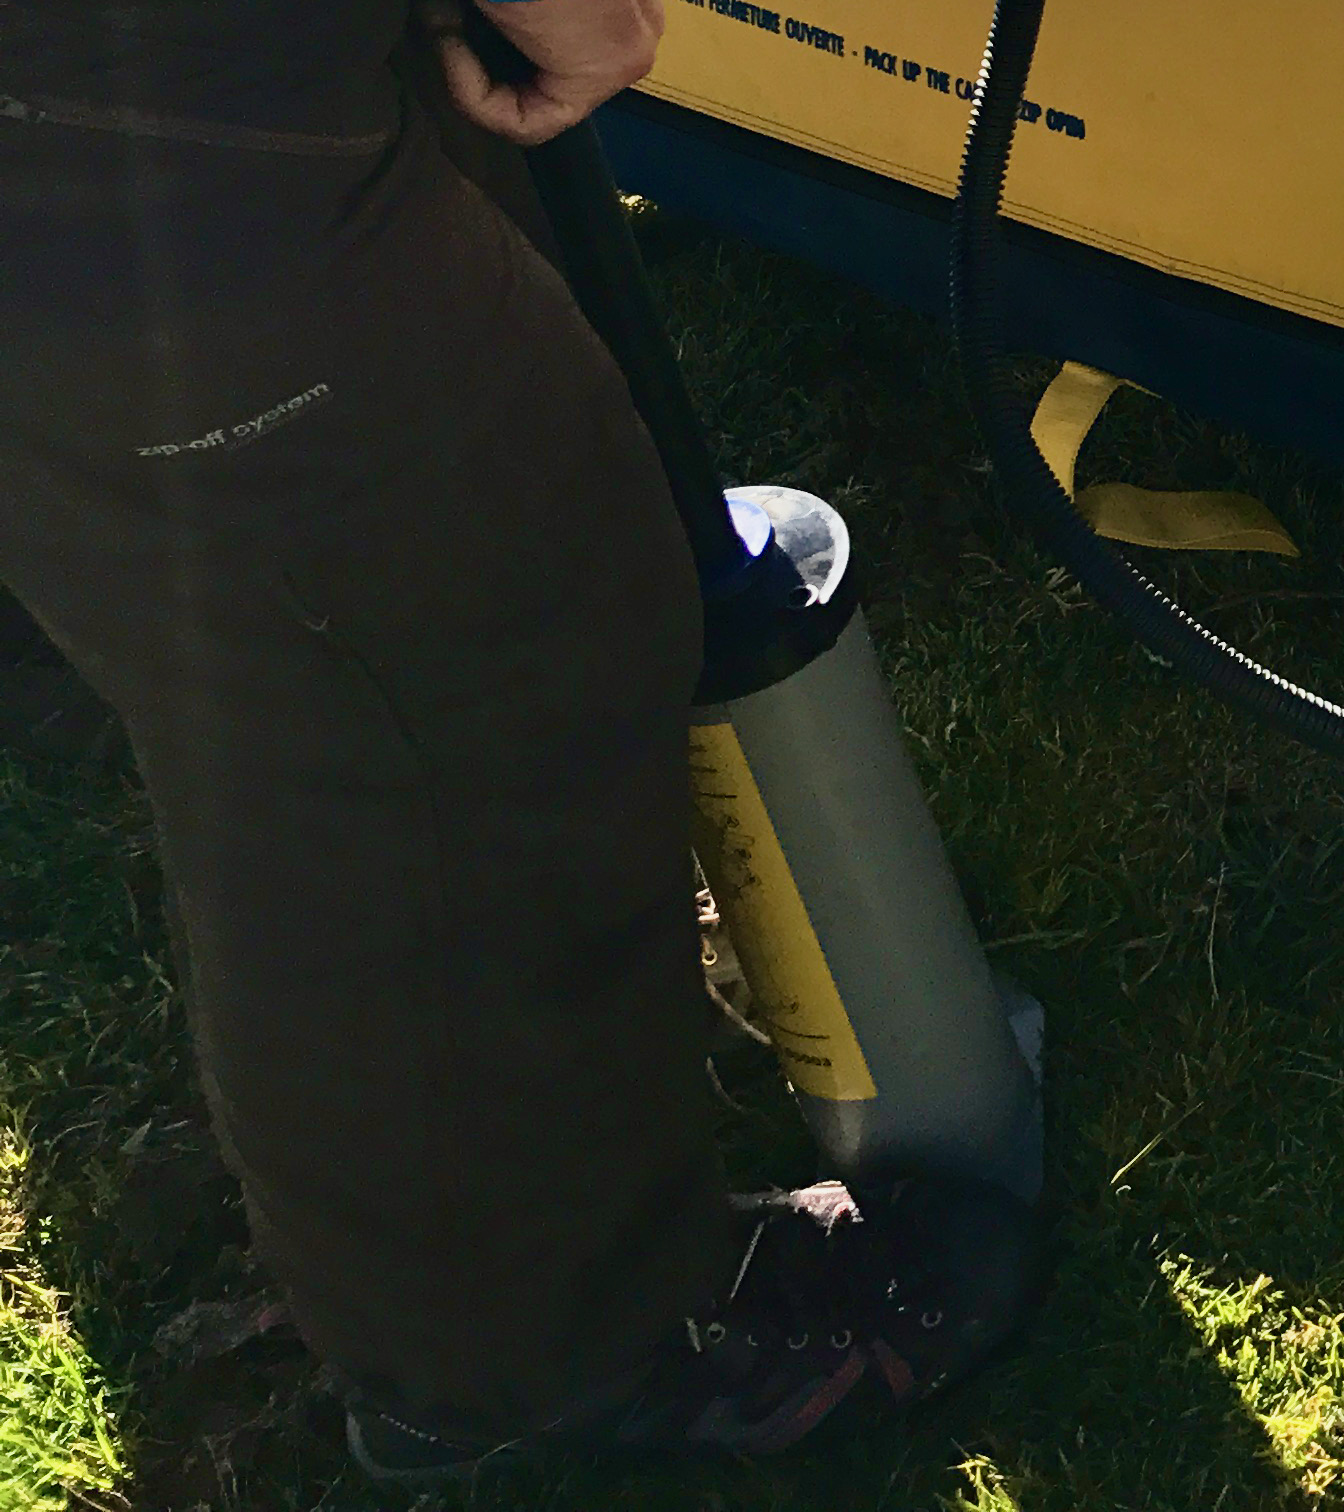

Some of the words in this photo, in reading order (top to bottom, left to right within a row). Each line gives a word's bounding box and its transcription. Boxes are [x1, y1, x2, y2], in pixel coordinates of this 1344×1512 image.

[785, 17, 845, 57] OUVERTE
[864, 45, 897, 76] PACK
[902, 59, 921, 82] UP
[926, 67, 950, 94] THE
